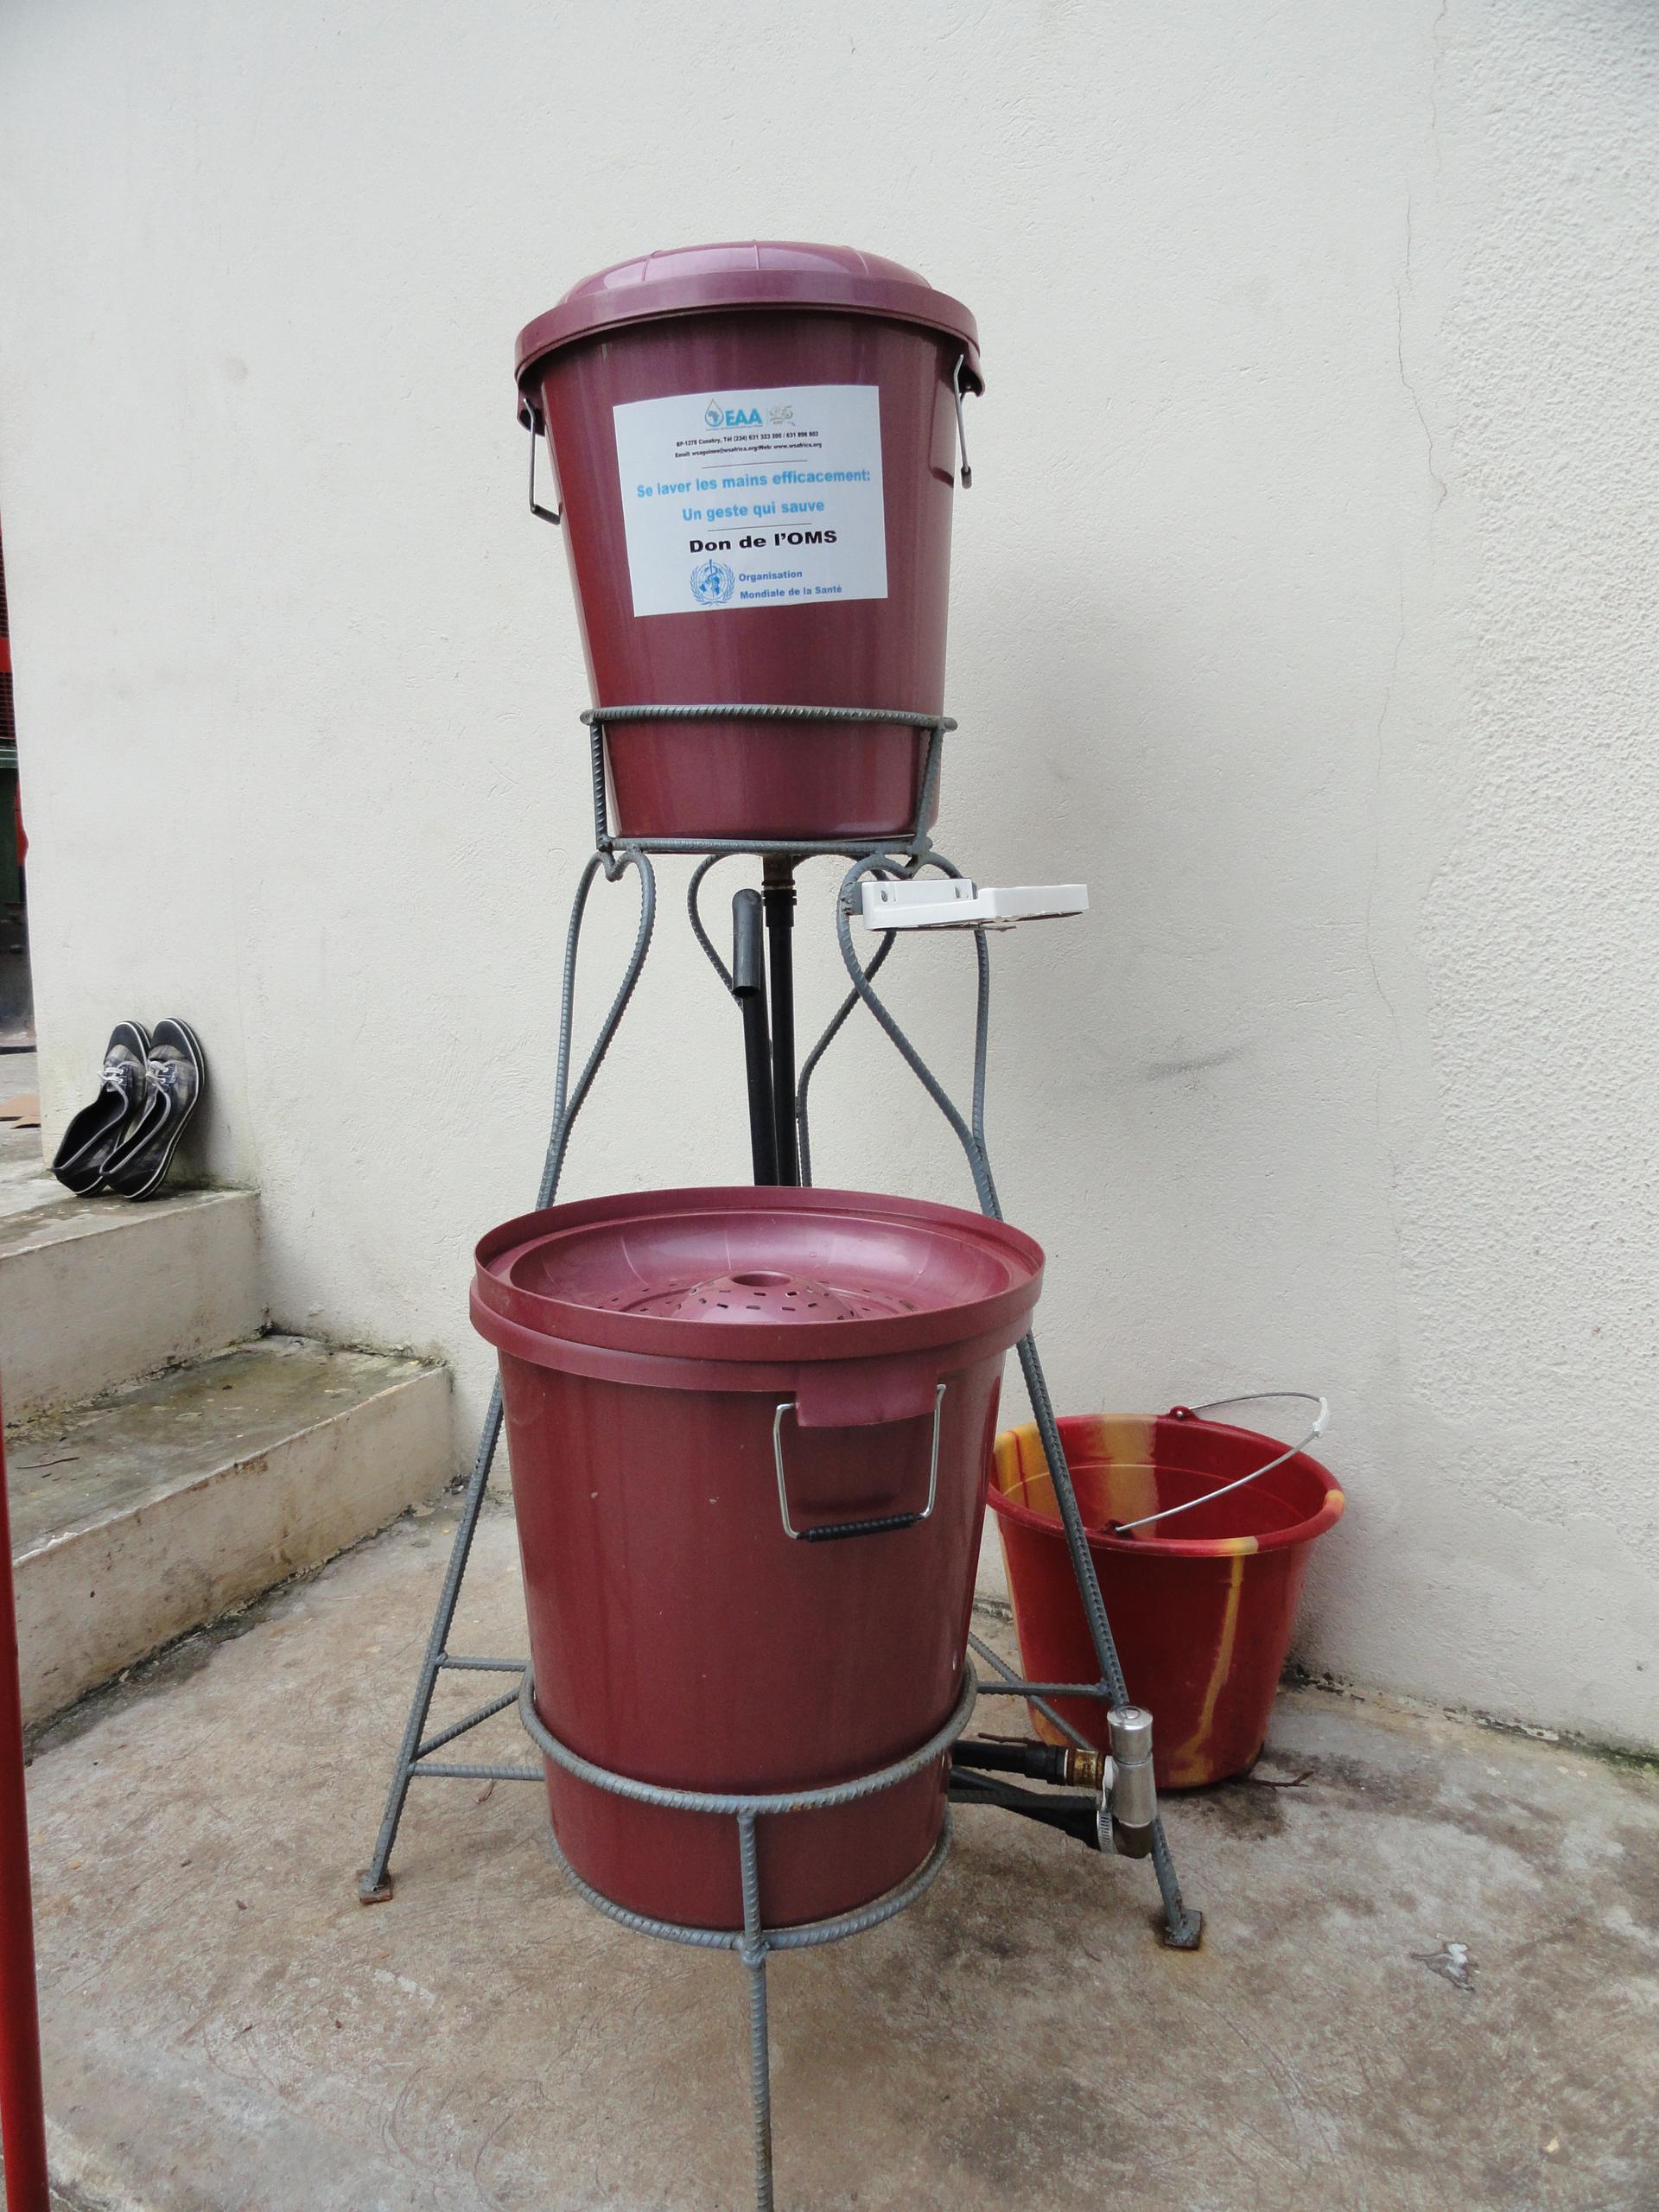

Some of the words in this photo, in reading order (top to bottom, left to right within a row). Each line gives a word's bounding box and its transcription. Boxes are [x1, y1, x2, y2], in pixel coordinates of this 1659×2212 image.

[725, 408, 763, 426] EAA
[637, 484, 653, 498] Se
[657, 482, 691, 496] laver
[696, 478, 717, 491] les
[722, 474, 767, 488] mains
[772, 469, 871, 485] efficacement:
[683, 508, 702, 521] Un
[707, 504, 747, 522] geste
[753, 500, 776, 518] qui
[781, 500, 824, 514] sauve
[690, 538, 731, 553] Don
[739, 534, 766, 548] de
[739, 570, 803, 583] Organisation
[740, 588, 785, 600] Mondiale
[788, 587, 800, 596] de
[803, 587, 812, 595] la
[815, 584, 842, 594] Santé
